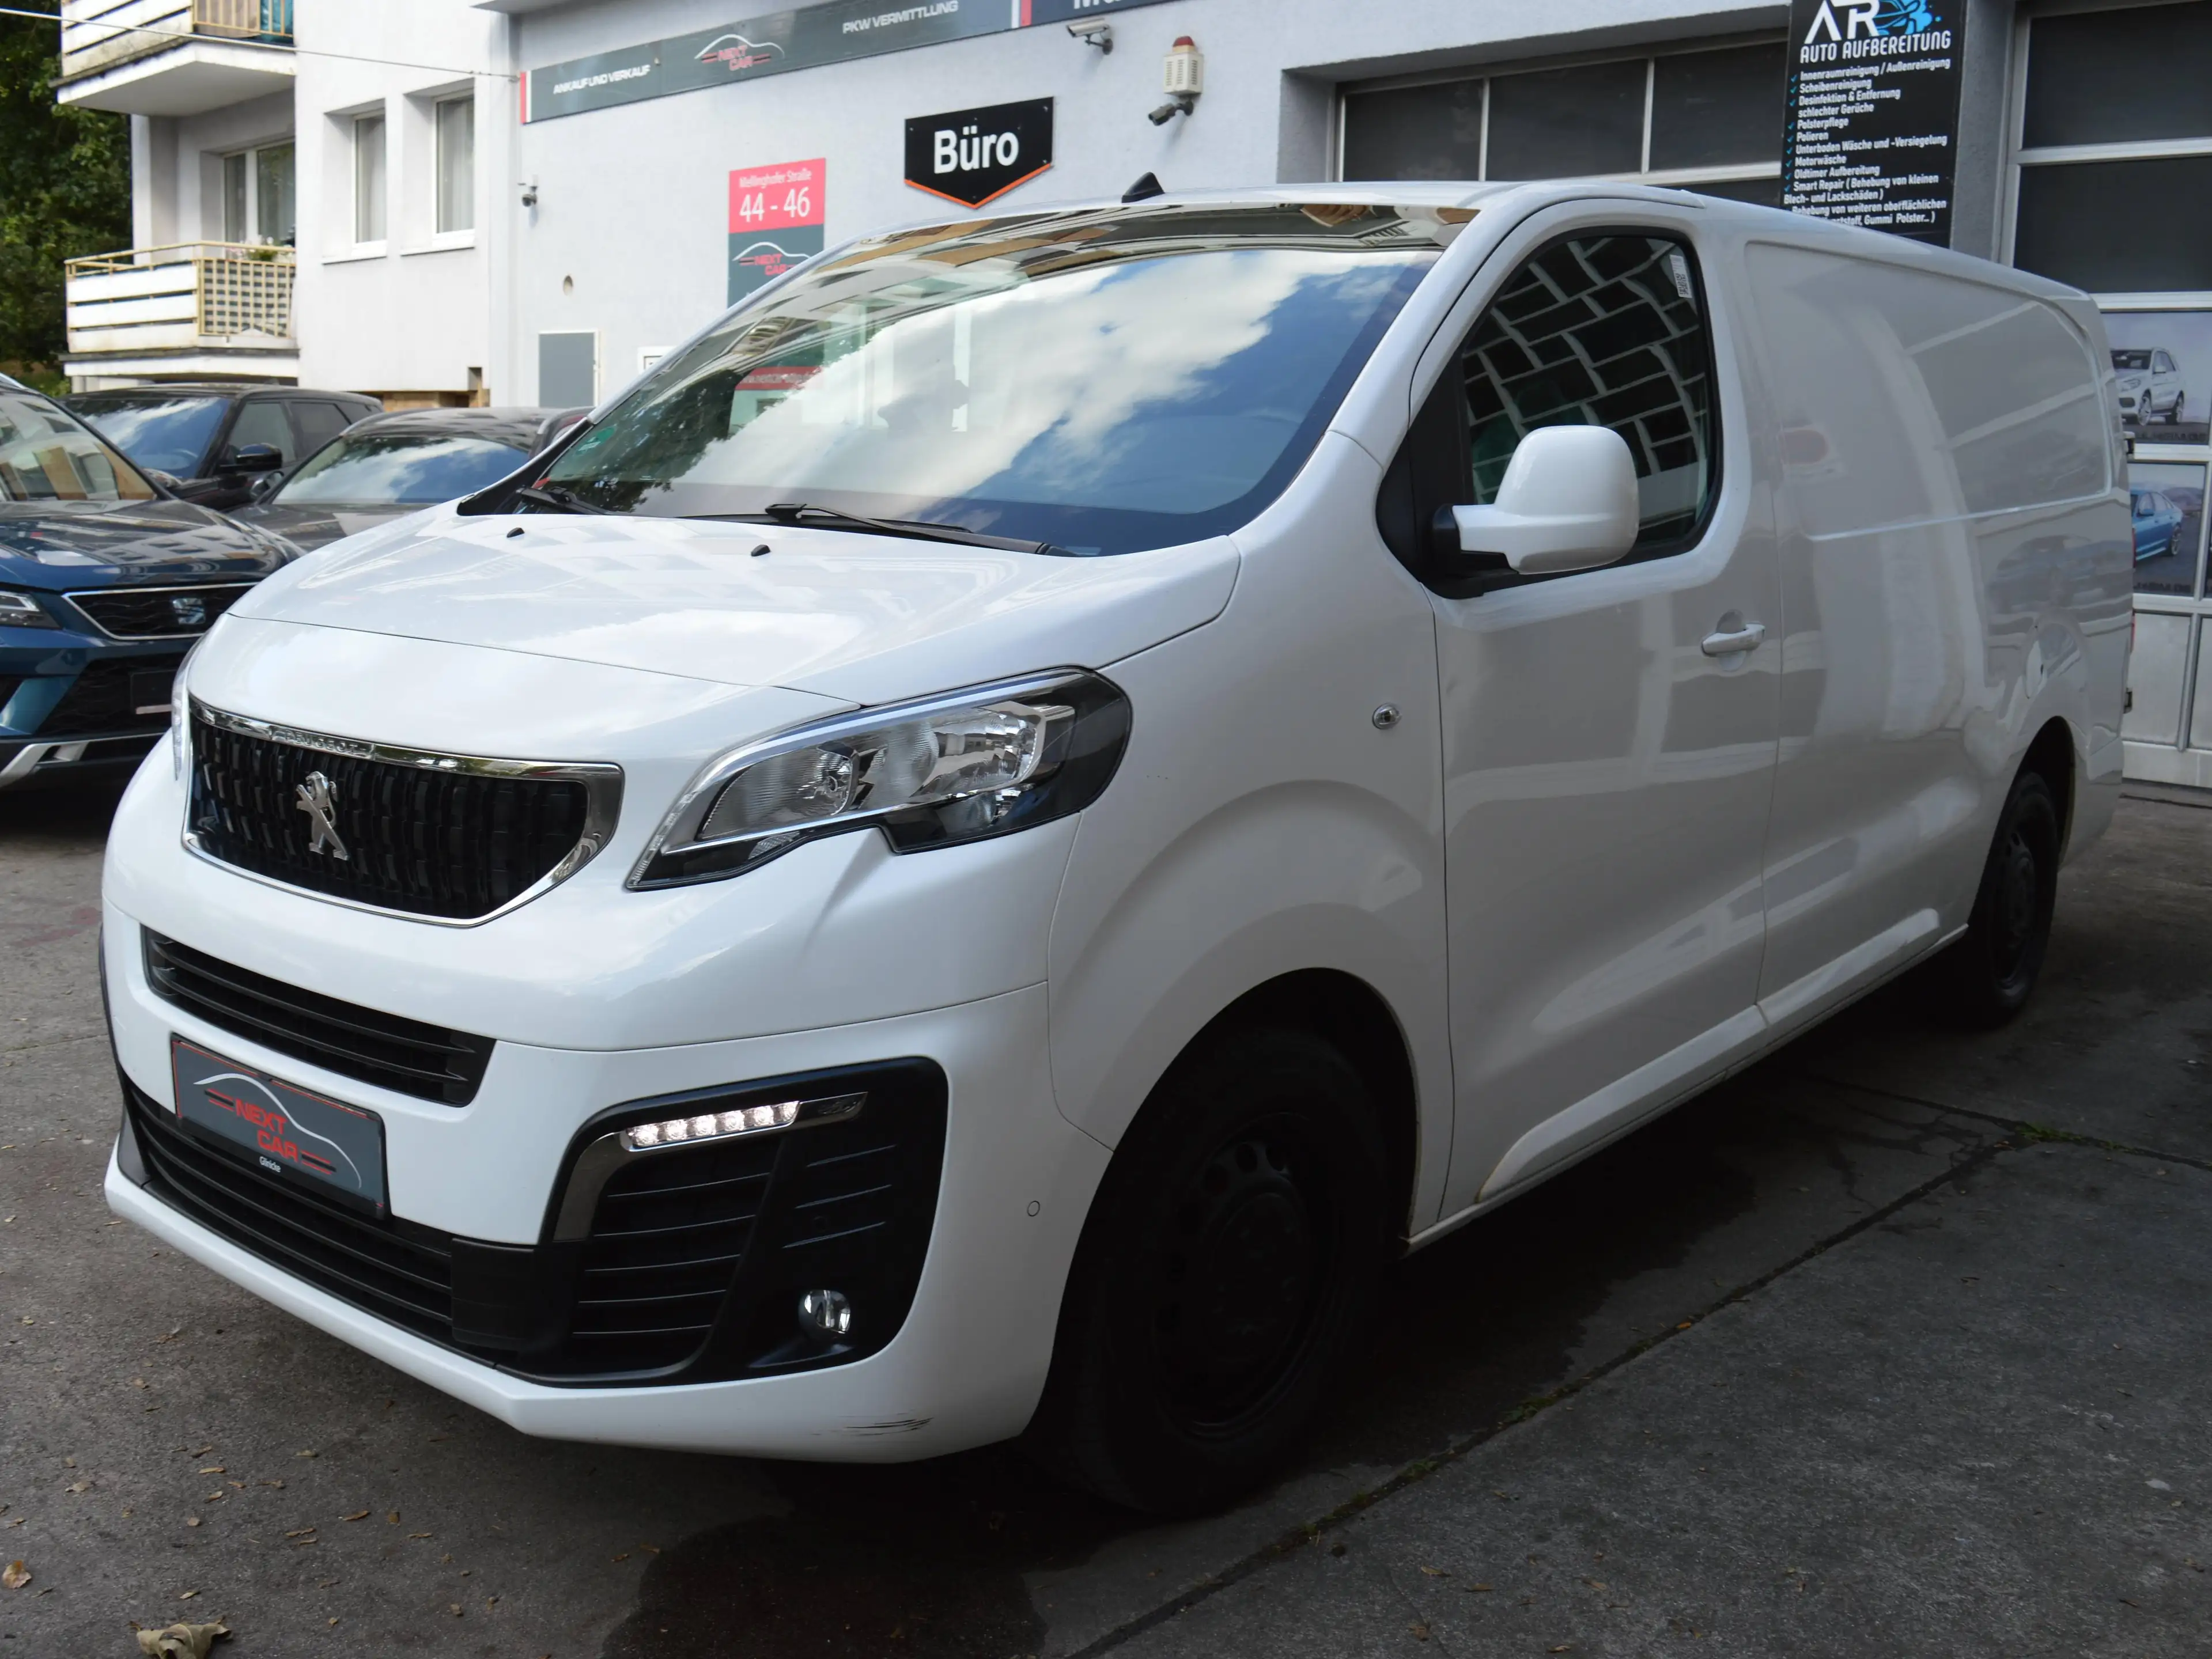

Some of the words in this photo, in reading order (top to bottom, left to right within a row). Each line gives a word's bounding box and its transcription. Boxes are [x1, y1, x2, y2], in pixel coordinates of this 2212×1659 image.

[842, 17, 871, 34] PKW
[872, 0, 959, 28] VERMITTLUNG
[1799, 43, 1837, 64] AUTO
[1842, 30, 1951, 59] AUFBEREITUNG
[729, 55, 753, 71] CAR
[1800, 65, 1880, 81] Innenraumreinigung
[1886, 58, 1951, 73] Außenreinigung
[553, 77, 588, 94] ANKAUF
[588, 73, 608, 87] UND
[608, 64, 651, 82] VERKAUF
[1799, 79, 1872, 94] Scheibenreinigung
[1798, 93, 1847, 106] Desinfektion
[1848, 90, 1855, 101] &
[1856, 89, 1901, 101] Entfernung
[1798, 106, 1840, 118] schlechter
[1840, 102, 1874, 115] Gerüche
[1797, 116, 1849, 130] Polsterpflege
[1796, 131, 1829, 142] Polieren
[934, 125, 1019, 174] Büro
[1795, 142, 1840, 154] Unterboden
[1842, 139, 1873, 151] Wäsche
[1873, 137, 1890, 149] und
[1794, 154, 1847, 166] Motorwäsche
[1794, 168, 1828, 180] Oldtimer
[1829, 165, 1880, 177] Aufbereitung
[1793, 180, 1818, 192] Smart
[1818, 179, 1844, 192] Repair
[1892, 176, 1907, 185] von
[1908, 173, 1939, 185] kleinen
[739, 192, 765, 223] 44
[784, 186, 811, 218] 46
[1810, 192, 1826, 203] und
[1827, 190, 1878, 202] Lackschäden
[1831, 206, 1846, 214] von
[1847, 202, 1882, 213] weiteren
[1864, 213, 1893, 225] Gummi
[754, 253, 782, 266] NEXT
[765, 263, 787, 275] CAR
[235, 1098, 287, 1135] NEXT
[257, 1129, 299, 1163] CAR
